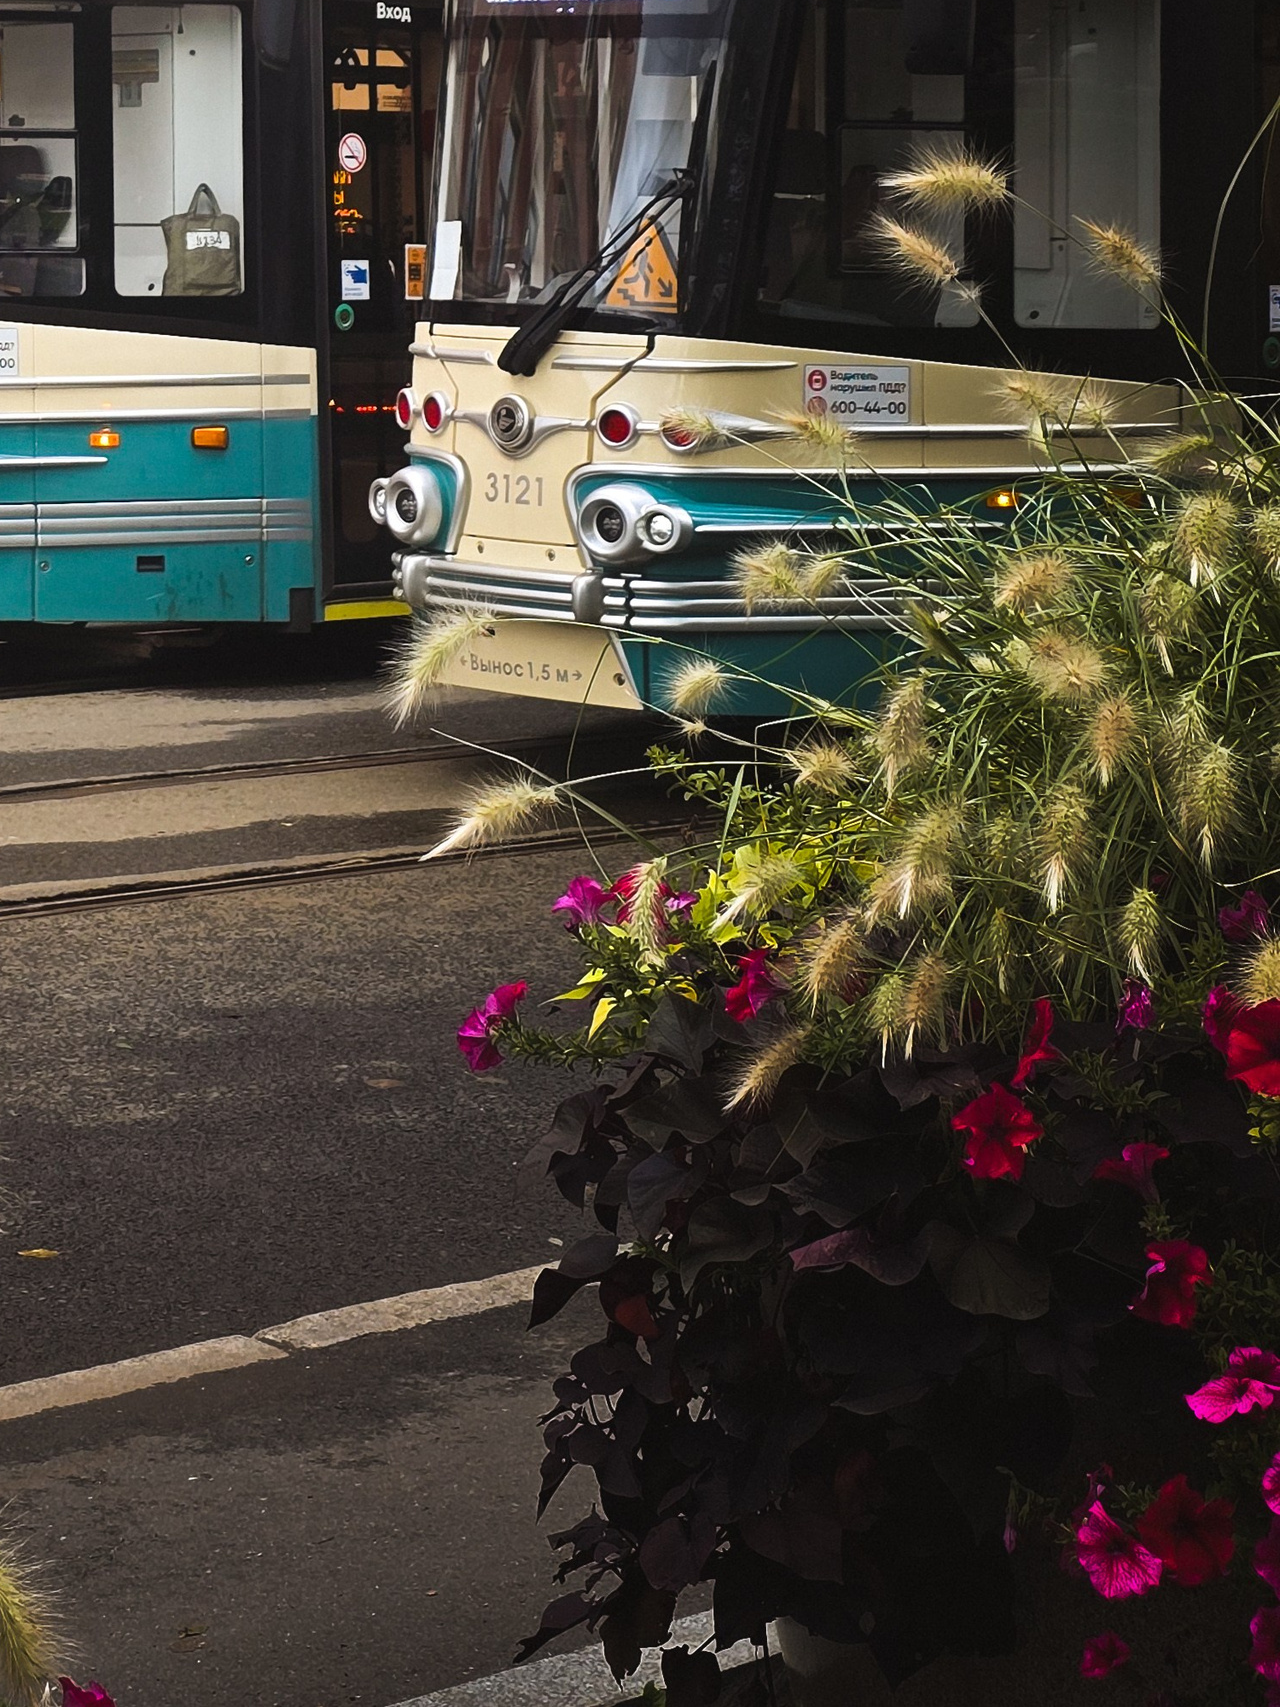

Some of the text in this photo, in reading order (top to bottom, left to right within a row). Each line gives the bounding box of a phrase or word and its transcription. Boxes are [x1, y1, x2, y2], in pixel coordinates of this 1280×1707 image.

[376, 2, 412, 22] Вход
[830, 400, 906, 414] 600-44-00
[485, 472, 543, 506] 3121
[470, 653, 523, 677] Вынос
[528, 661, 551, 681] 1,5
